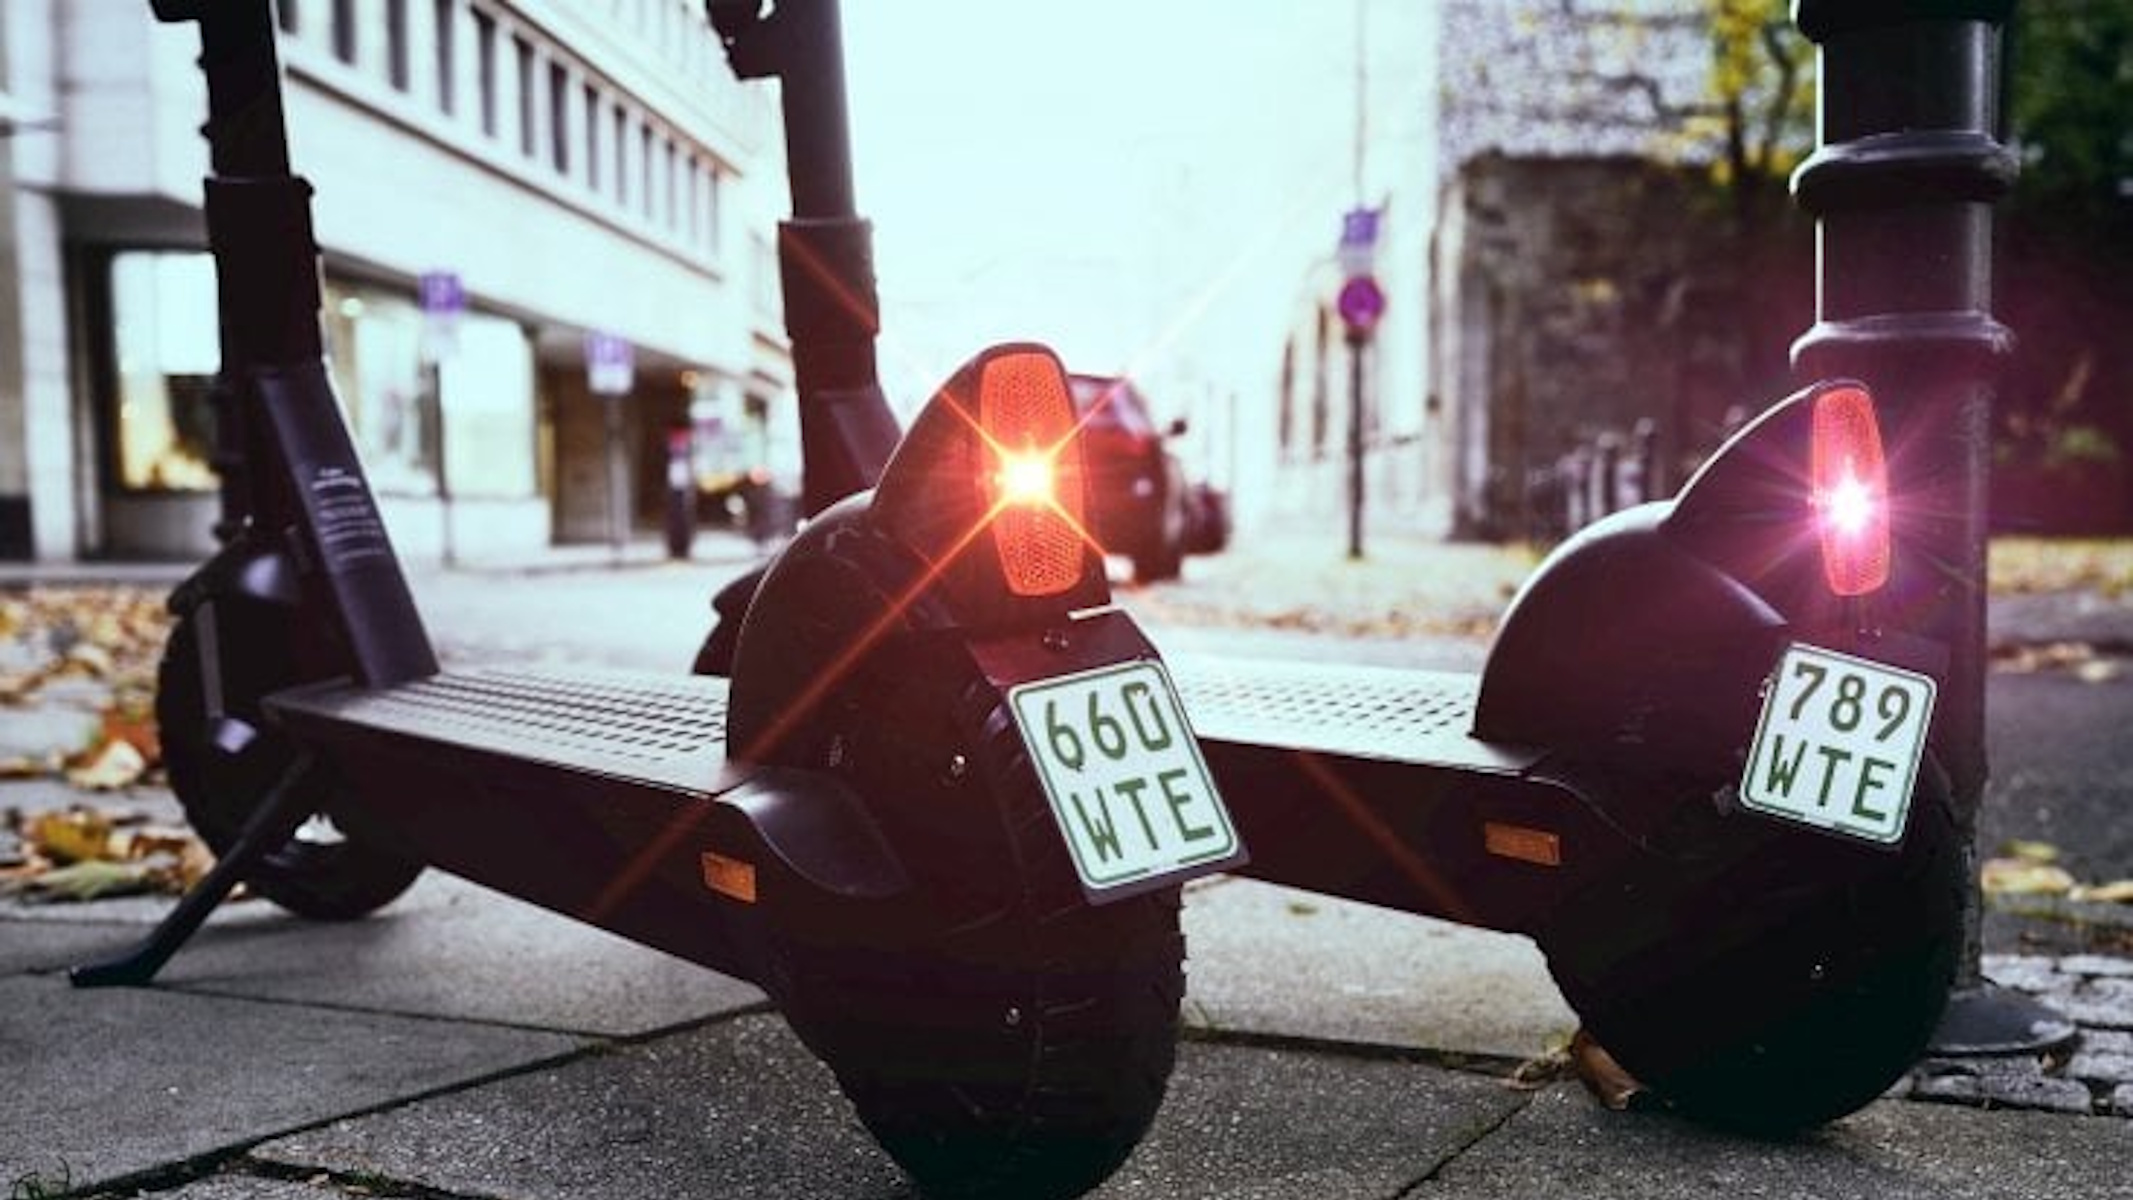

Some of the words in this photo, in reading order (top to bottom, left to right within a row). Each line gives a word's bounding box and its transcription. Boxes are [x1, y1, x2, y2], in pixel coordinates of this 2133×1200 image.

[1046, 682, 1172, 772] 660
[1789, 662, 1912, 742] 789
[1071, 769, 1215, 863] WTE
[1765, 733, 1897, 822] WTE
